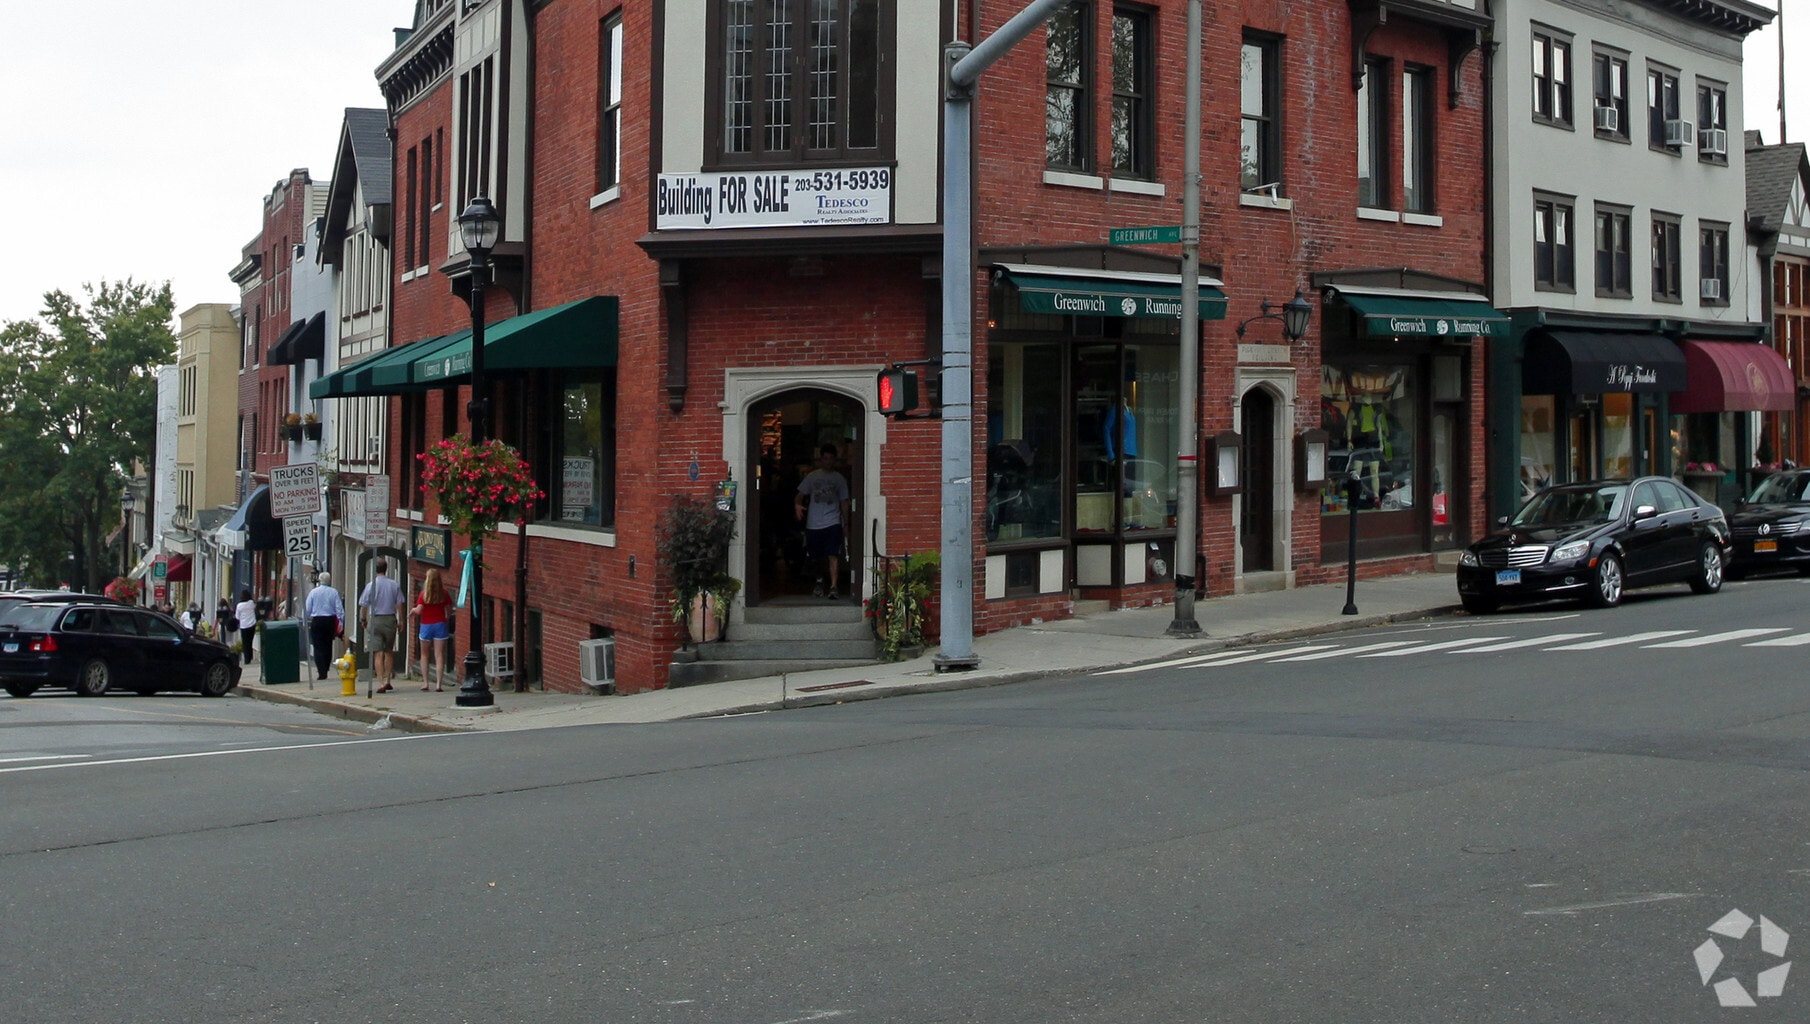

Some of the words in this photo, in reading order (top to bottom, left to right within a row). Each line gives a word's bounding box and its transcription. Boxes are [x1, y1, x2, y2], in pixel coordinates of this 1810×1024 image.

[795, 169, 889, 191] 203-531-5939
[658, 178, 712, 224] Building
[719, 176, 747, 214] FOR
[754, 175, 789, 213] SALE
[815, 194, 869, 208] TEDESCO
[1115, 229, 1158, 242] GREENWICH
[1054, 293, 1105, 312] Greenwich
[1145, 298, 1182, 319] Running
[1390, 317, 1427, 333] Greenwich
[1453, 319, 1480, 336] Running
[274, 466, 314, 480] TRUCKS
[275, 479, 291, 488] OVER
[301, 477, 314, 485] FEET
[273, 491, 284, 500] NO
[287, 487, 317, 498] PARKING
[286, 518, 311, 528] SPEED
[289, 527, 308, 536] LIMIT
[288, 536, 312, 553] 25
